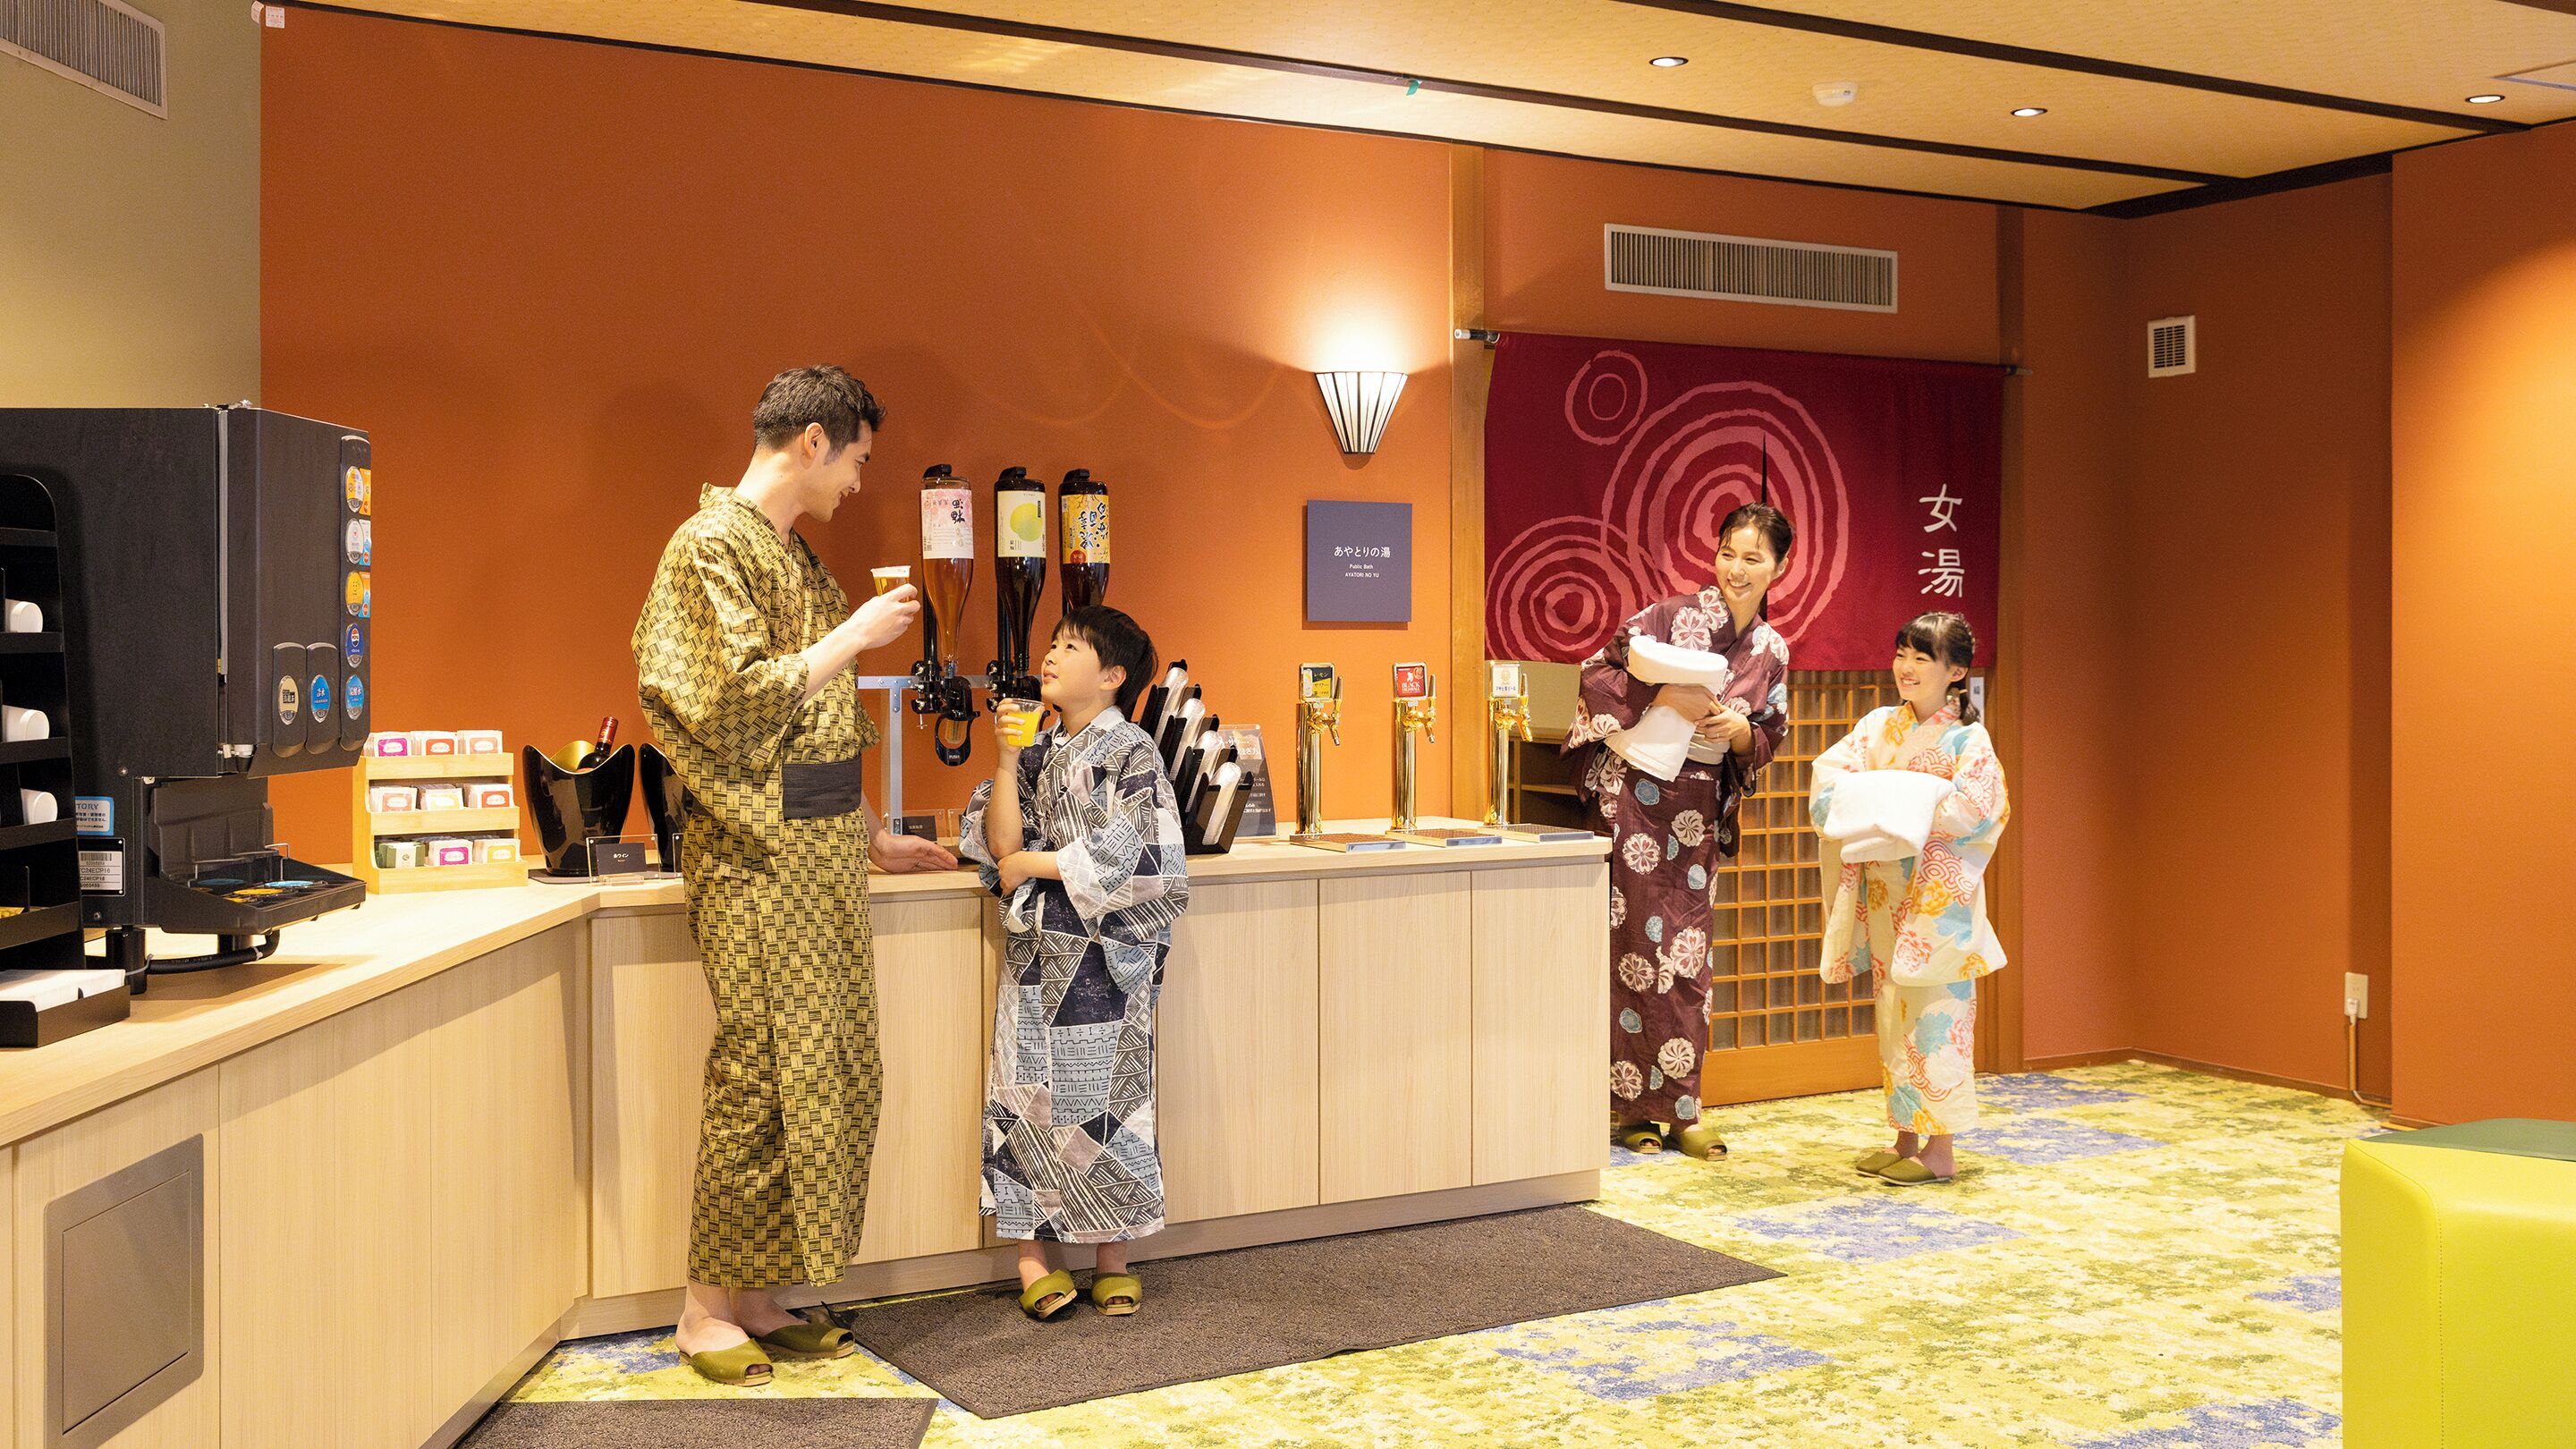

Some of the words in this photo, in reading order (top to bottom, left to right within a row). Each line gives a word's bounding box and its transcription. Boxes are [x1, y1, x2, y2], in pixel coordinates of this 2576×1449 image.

[950, 498, 966, 524] 梅酒
[1334, 546, 1391, 558] あやとりの湯
[1918, 483, 1965, 598] 女湯
